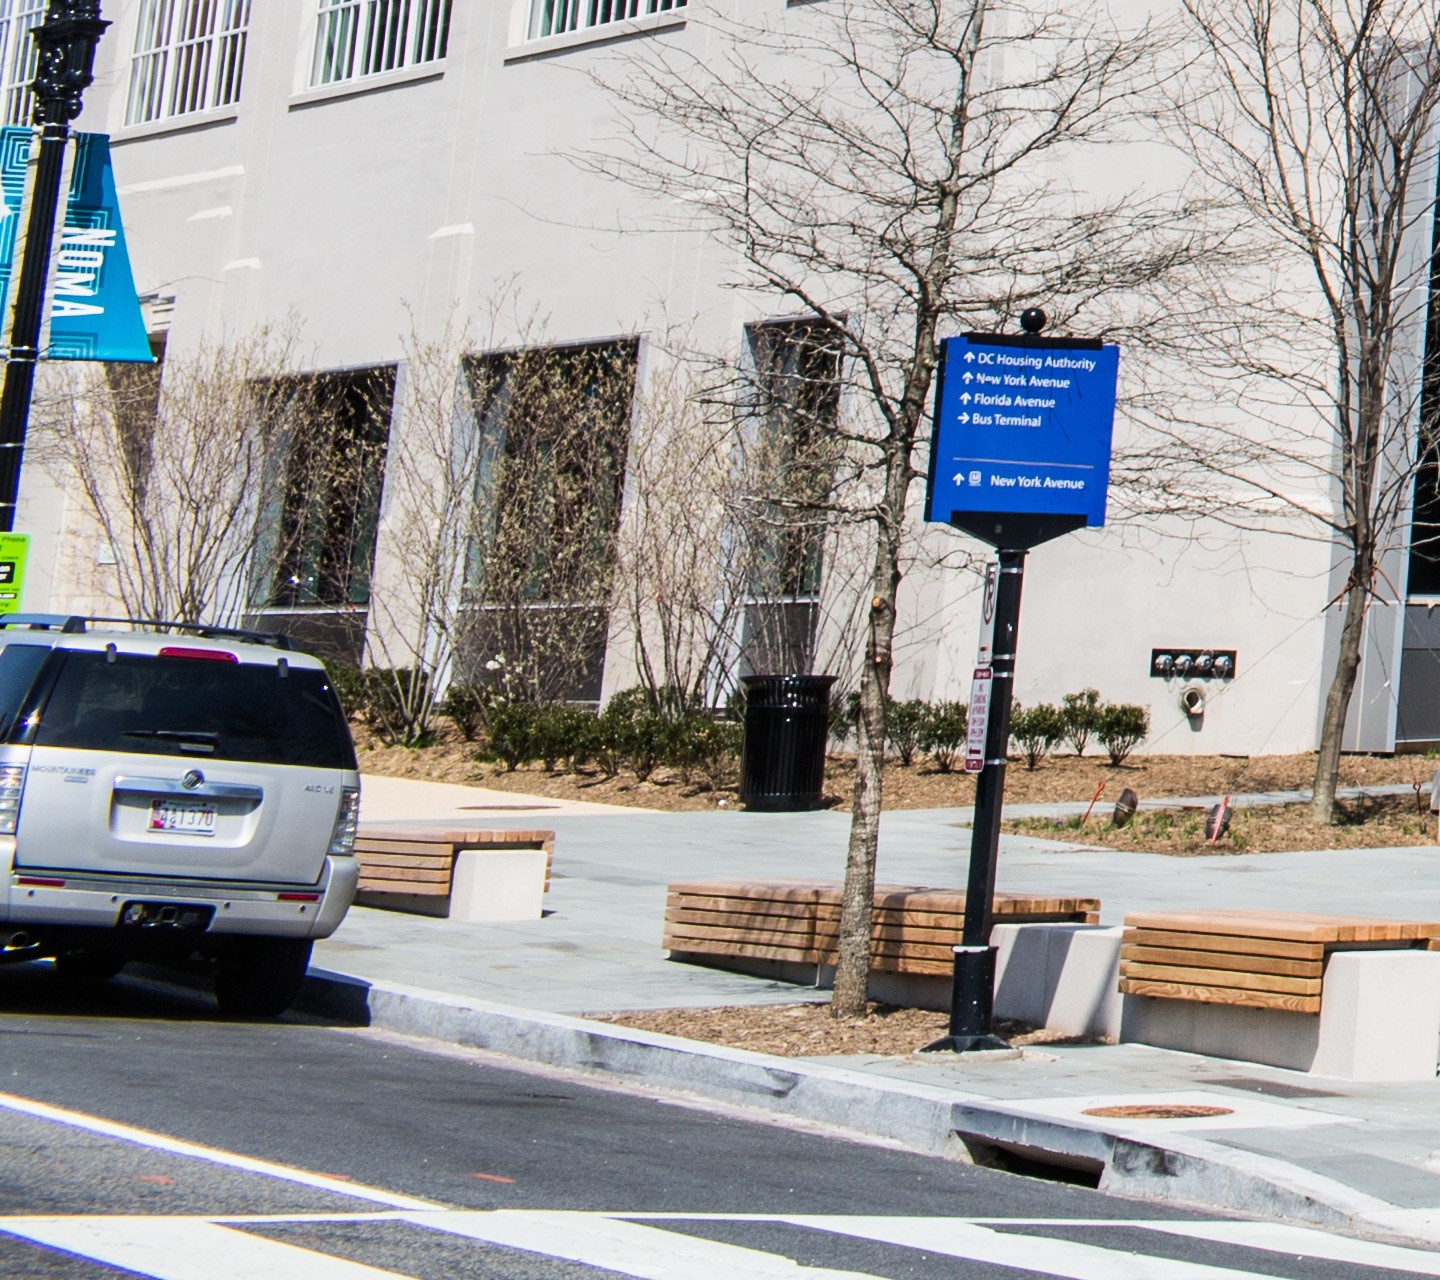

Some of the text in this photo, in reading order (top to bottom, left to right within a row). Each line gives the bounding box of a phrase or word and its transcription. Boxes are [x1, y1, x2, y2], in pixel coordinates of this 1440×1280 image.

[977, 352, 1096, 372] DC Housing Authority
[1003, 374, 1027, 387] York
[1029, 376, 1071, 389] Avenue
[974, 392, 1056, 408] Florida Avenue
[972, 412, 1042, 427] Bus Terminal
[990, 474, 1016, 487] New
[1018, 476, 1041, 488] York
[1043, 477, 1085, 489] Avenue
